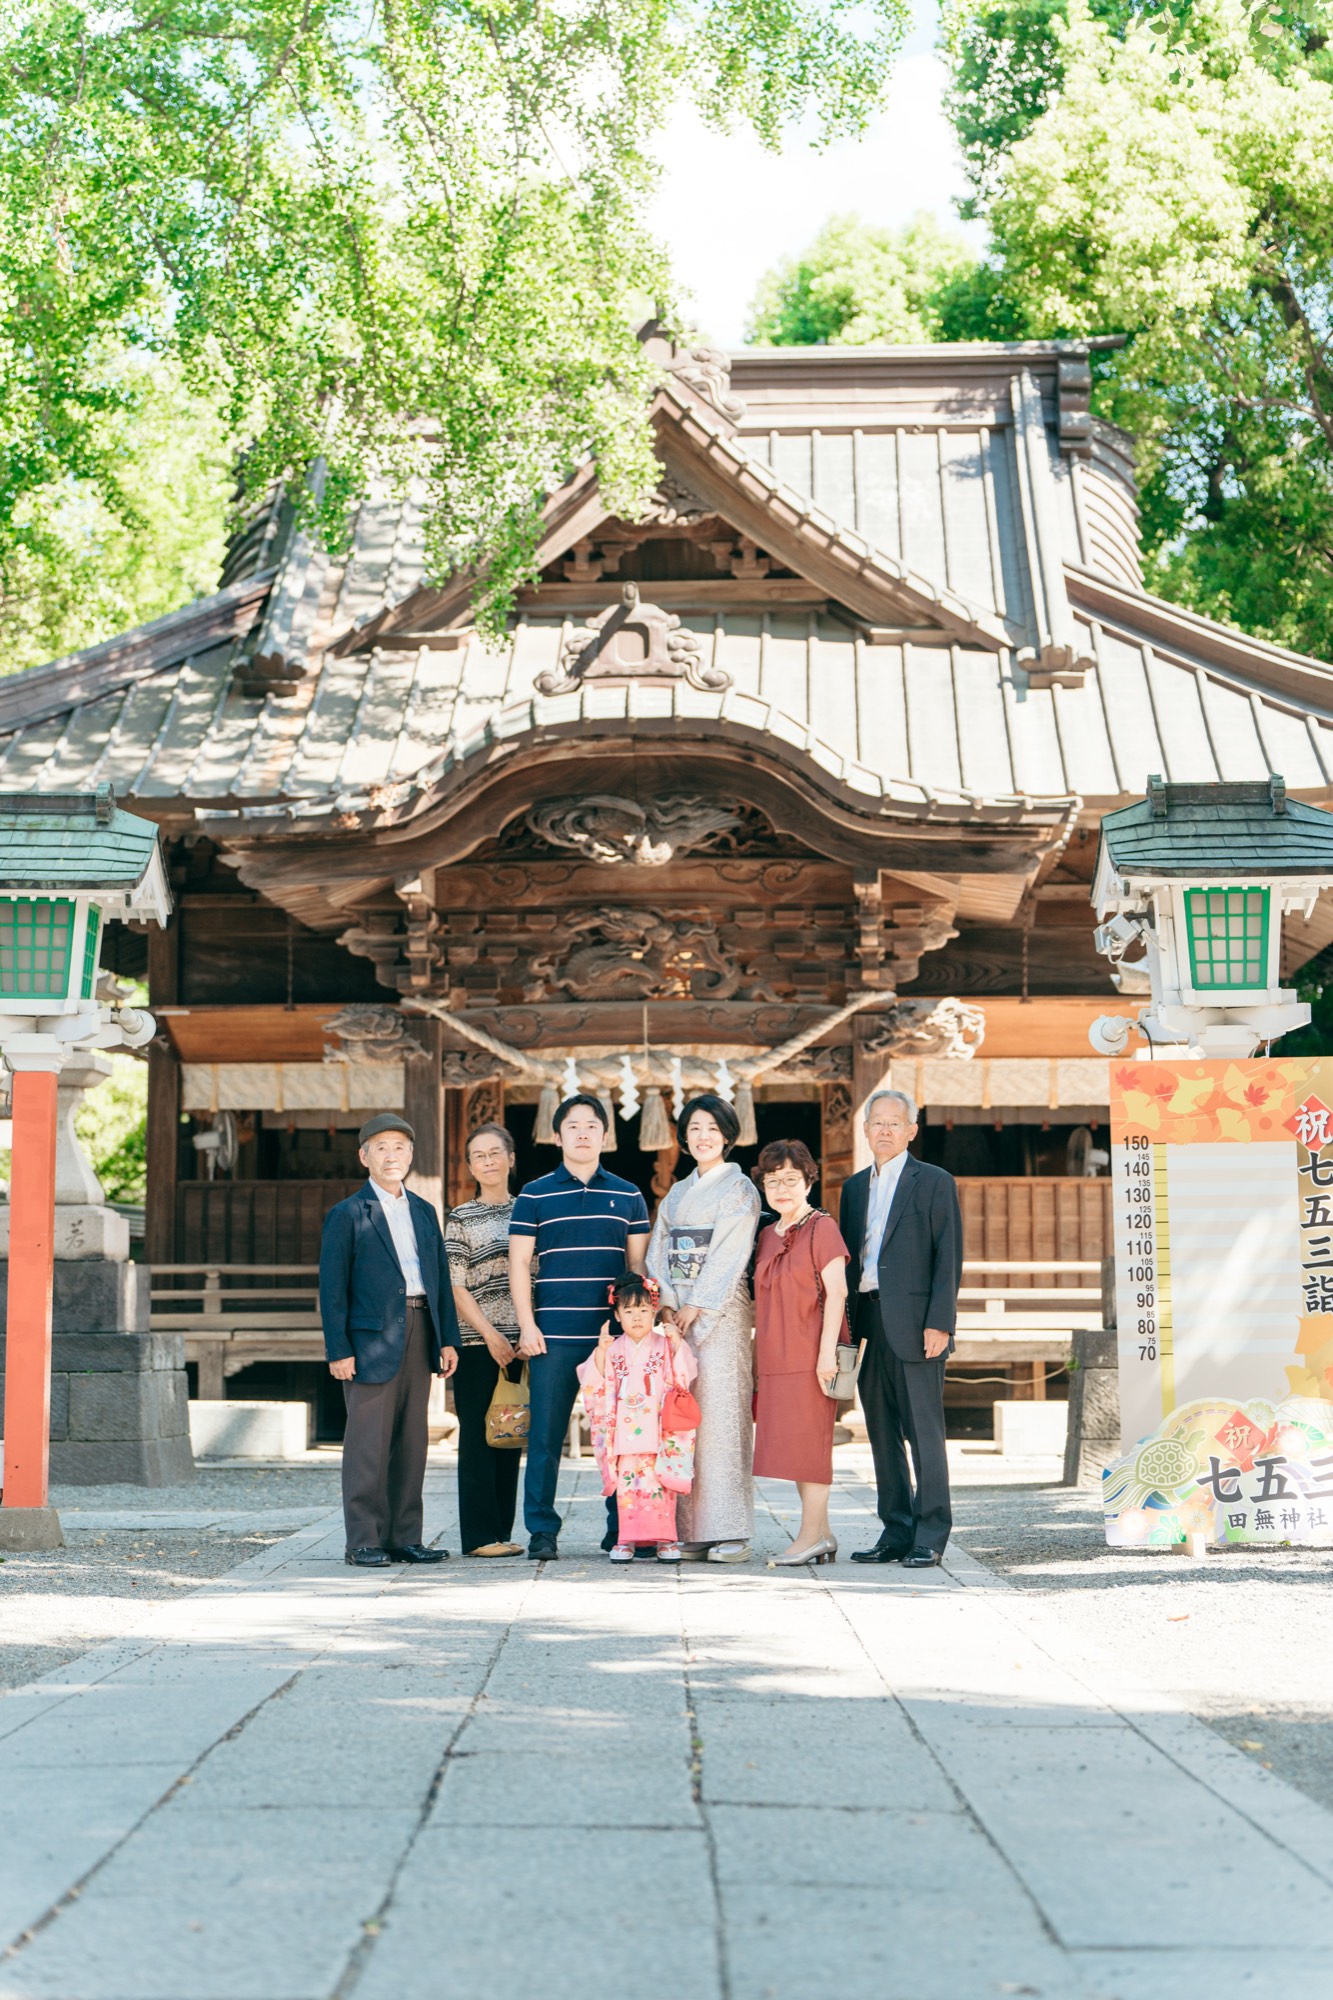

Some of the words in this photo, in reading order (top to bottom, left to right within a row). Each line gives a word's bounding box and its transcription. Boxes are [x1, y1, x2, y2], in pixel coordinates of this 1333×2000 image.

[1295, 1104, 1333, 1145] 祝
[1124, 1135, 1149, 1150] 150
[1124, 1161, 1150, 1176] 140
[1125, 1188, 1151, 1203] 130
[1126, 1214, 1152, 1229] 120
[1299, 1151, 1333, 1313] 七五三詣
[1127, 1240, 1152, 1255] 110
[1128, 1266, 1154, 1282] 100
[1136, 1293, 1154, 1308] 90
[1137, 1319, 1155, 1334] 80
[1147, 1337, 1156, 1345] 75
[1138, 1345, 1156, 1361] 70
[1224, 1422, 1252, 1450] 祝
[1228, 1507, 1329, 1531] 田無神社
